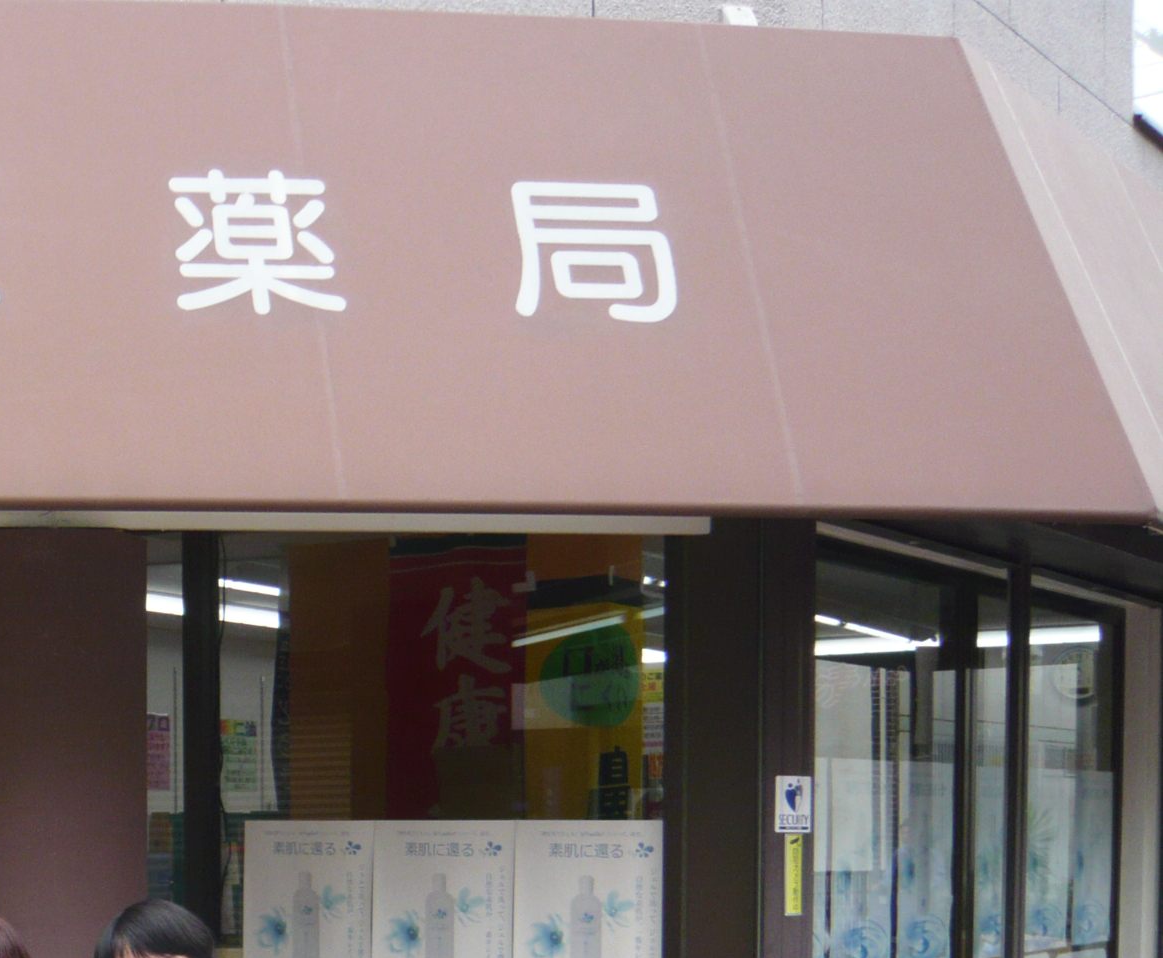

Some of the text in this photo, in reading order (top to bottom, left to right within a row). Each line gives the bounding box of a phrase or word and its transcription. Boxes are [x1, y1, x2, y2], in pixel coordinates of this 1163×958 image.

[421, 576, 513, 753] 健康
[272, 841, 336, 856] 素肌に還る
[405, 841, 475, 857] 素肌に還る
[548, 842, 624, 859] 素肌に還る
